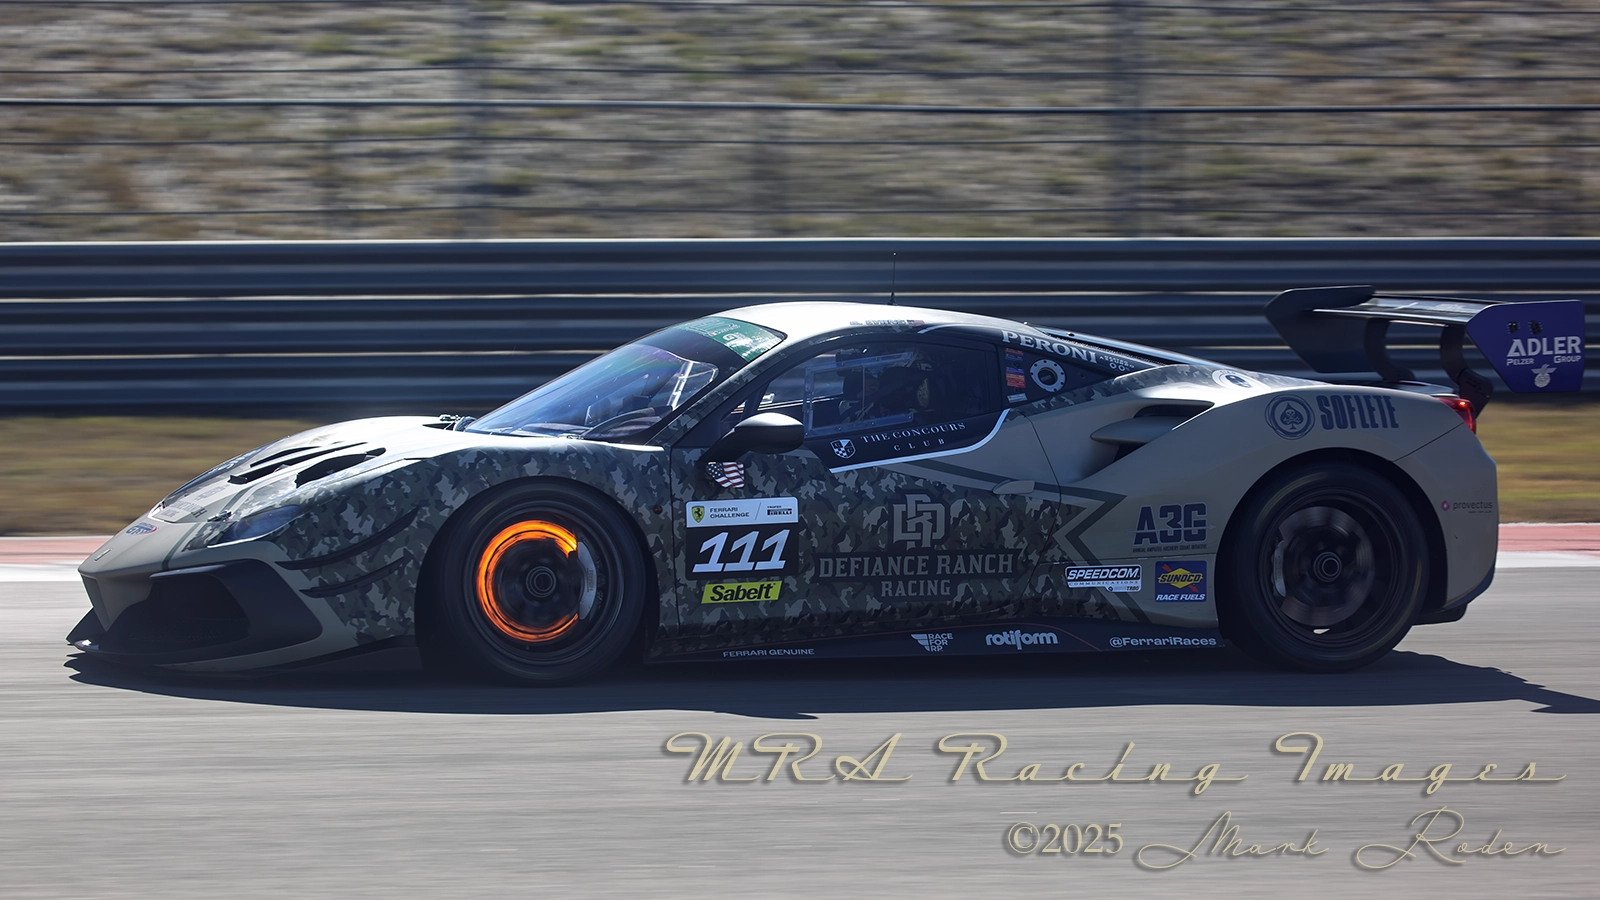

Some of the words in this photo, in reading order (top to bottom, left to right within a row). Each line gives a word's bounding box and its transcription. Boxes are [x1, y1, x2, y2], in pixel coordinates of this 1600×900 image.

[1001, 330, 1098, 363] PERONI
[1506, 336, 1581, 357] ADLER
[1506, 358, 1534, 366] PELZER
[1553, 355, 1581, 364] GROUP
[1316, 395, 1399, 430] SOFLETE
[860, 432, 890, 443] THE
[892, 422, 966, 439] CONCOURS
[767, 508, 793, 516] PIRELLI
[1453, 501, 1493, 510] provectus
[1133, 503, 1207, 545] A3G
[692, 529, 790, 573] 111
[819, 555, 929, 577] DEFIANCE
[936, 553, 1014, 575] RANCH
[1067, 568, 1139, 580] SPEEDCOM
[1159, 573, 1202, 583] SUNOCO
[710, 583, 773, 602] Sabelt
[881, 579, 950, 597] RACING
[985, 629, 1058, 650] rotiform
[1109, 637, 1217, 648] @FerrariRaces
[723, 649, 767, 658] FERRARI
[769, 648, 815, 656] GENUINE
